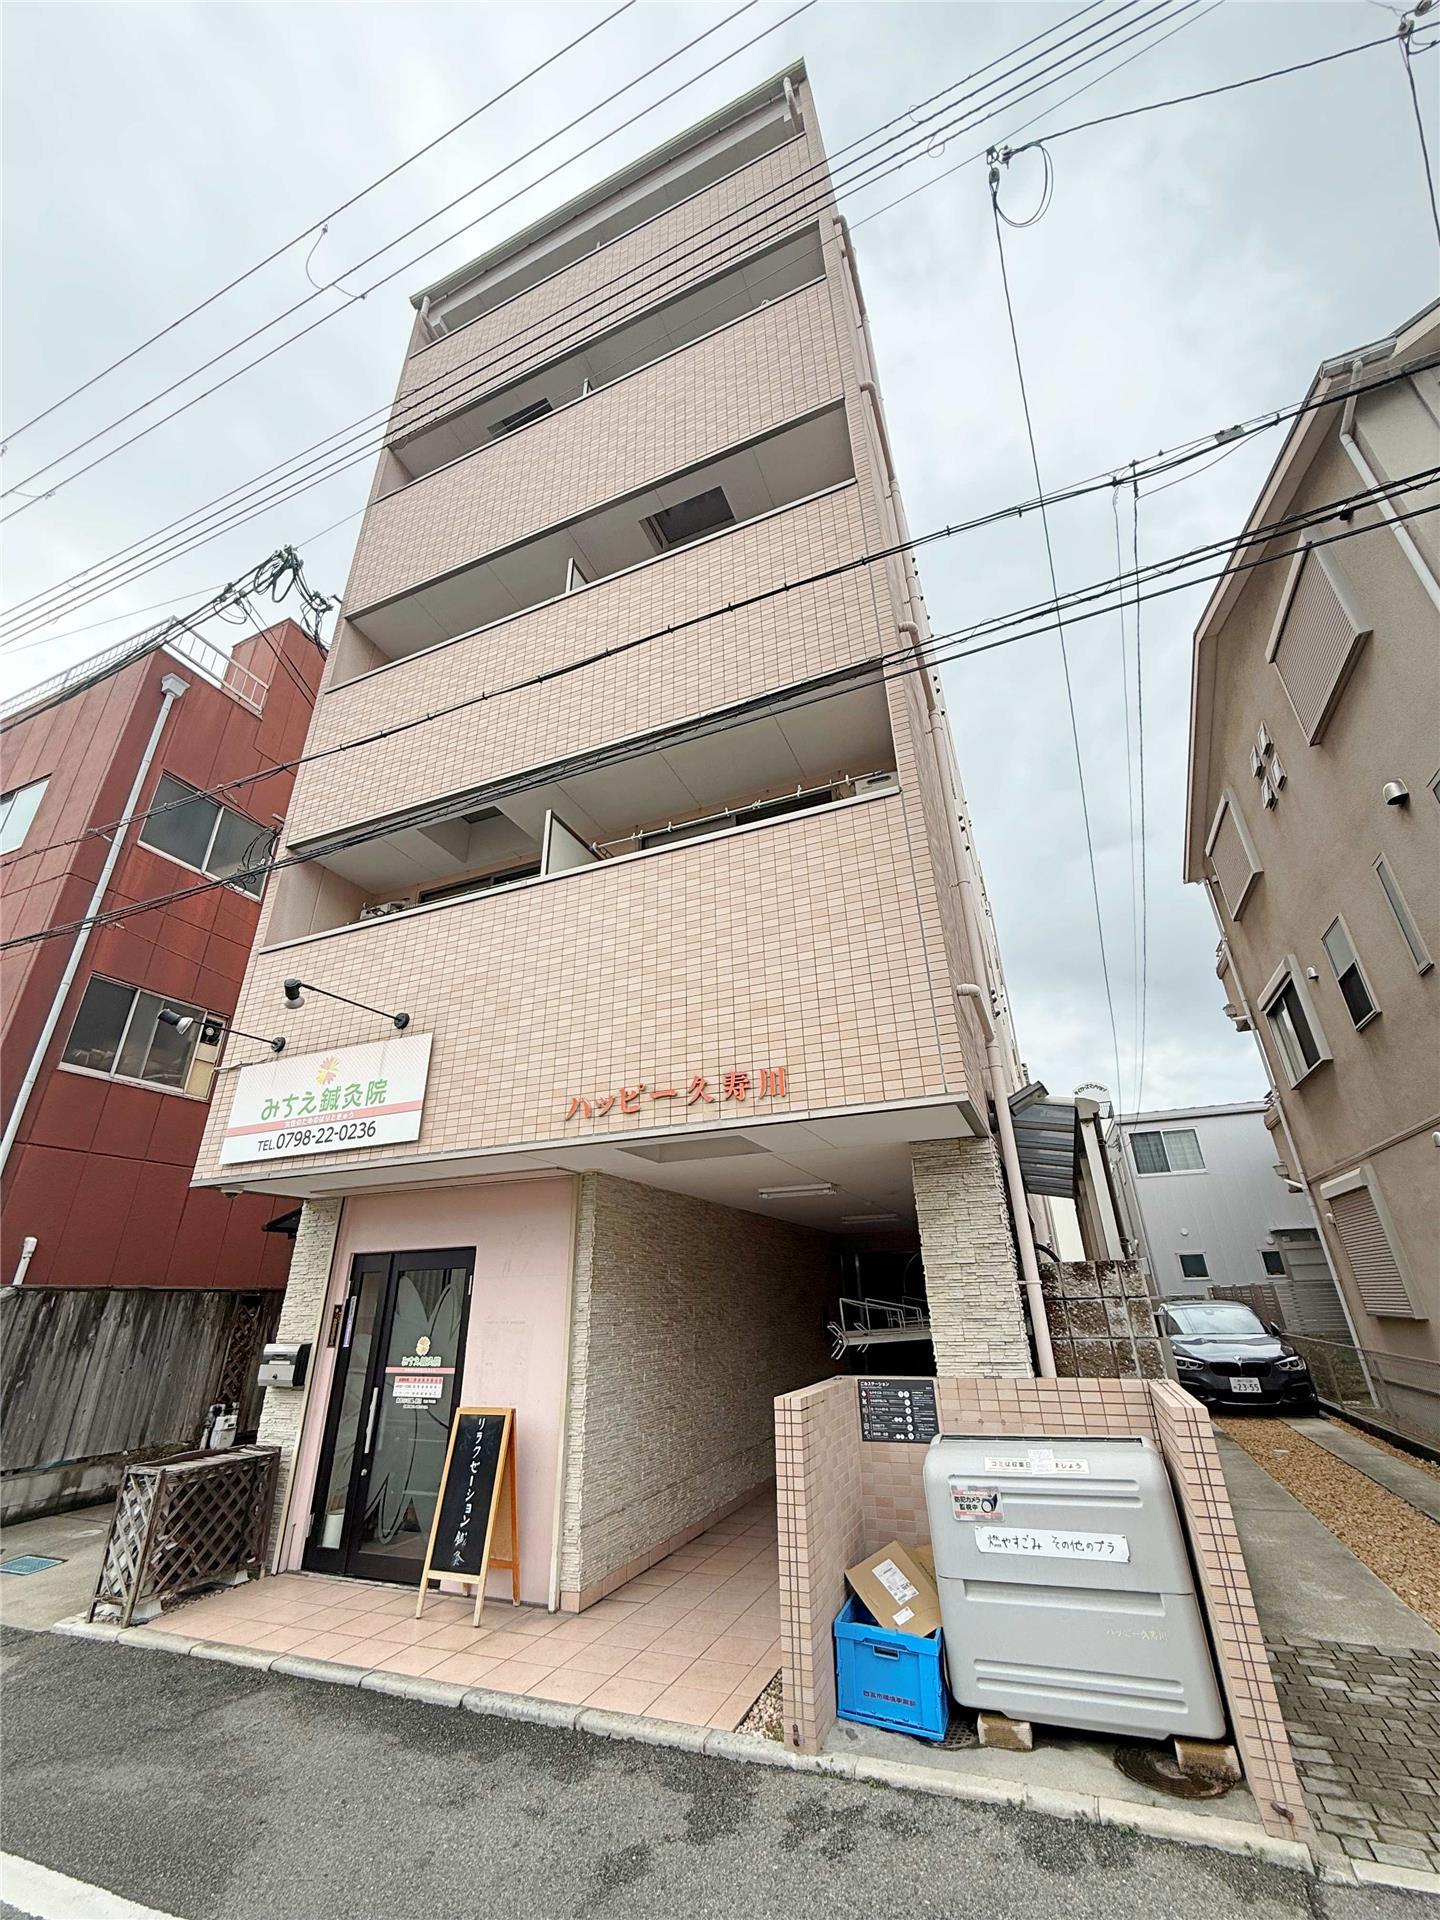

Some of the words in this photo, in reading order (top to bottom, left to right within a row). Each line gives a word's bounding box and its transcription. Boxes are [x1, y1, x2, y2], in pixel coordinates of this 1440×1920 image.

[261, 1078, 387, 1120] みちえ鍼灸院
[565, 1066, 788, 1121] ハッピー久寿川
